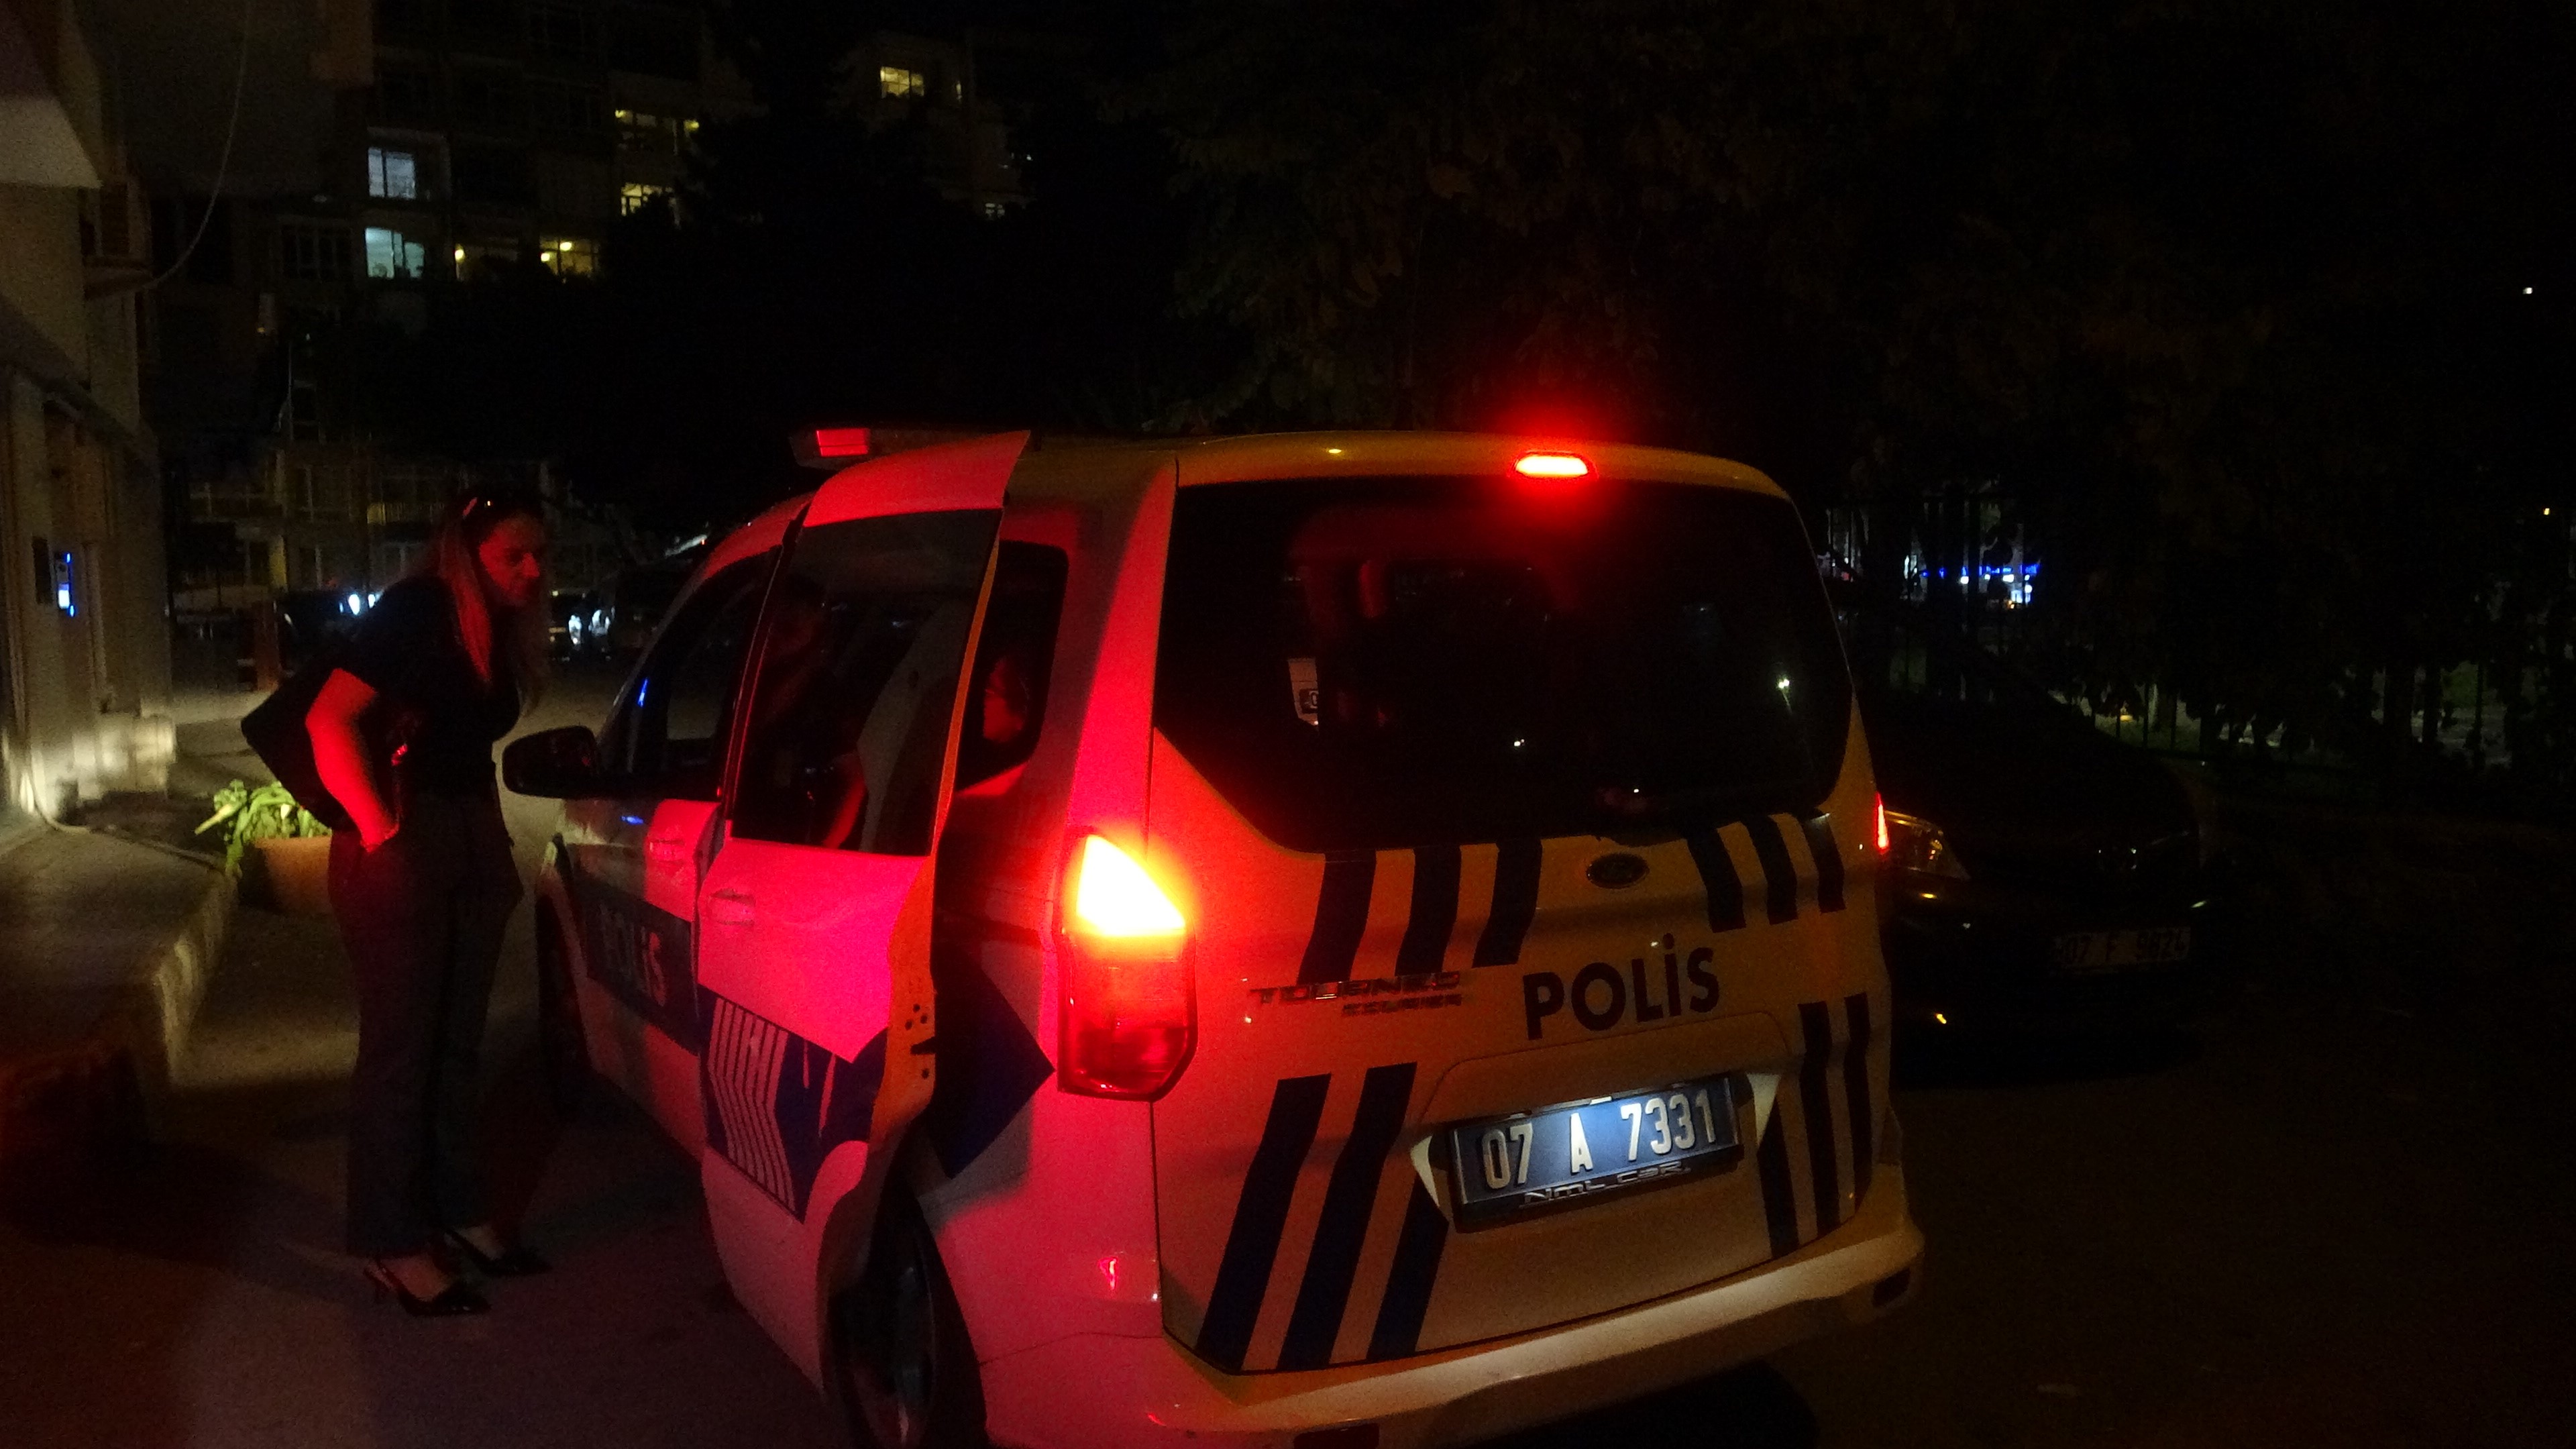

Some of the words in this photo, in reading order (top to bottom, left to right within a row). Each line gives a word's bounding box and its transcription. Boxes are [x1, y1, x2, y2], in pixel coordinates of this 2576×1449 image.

[1522, 932, 1719, 1040] POLİS
[2064, 934, 2092, 964] 07
[1481, 1122, 1534, 1190] 07
[1570, 1112, 1594, 1175] A
[1620, 1088, 1717, 1163] 7331
